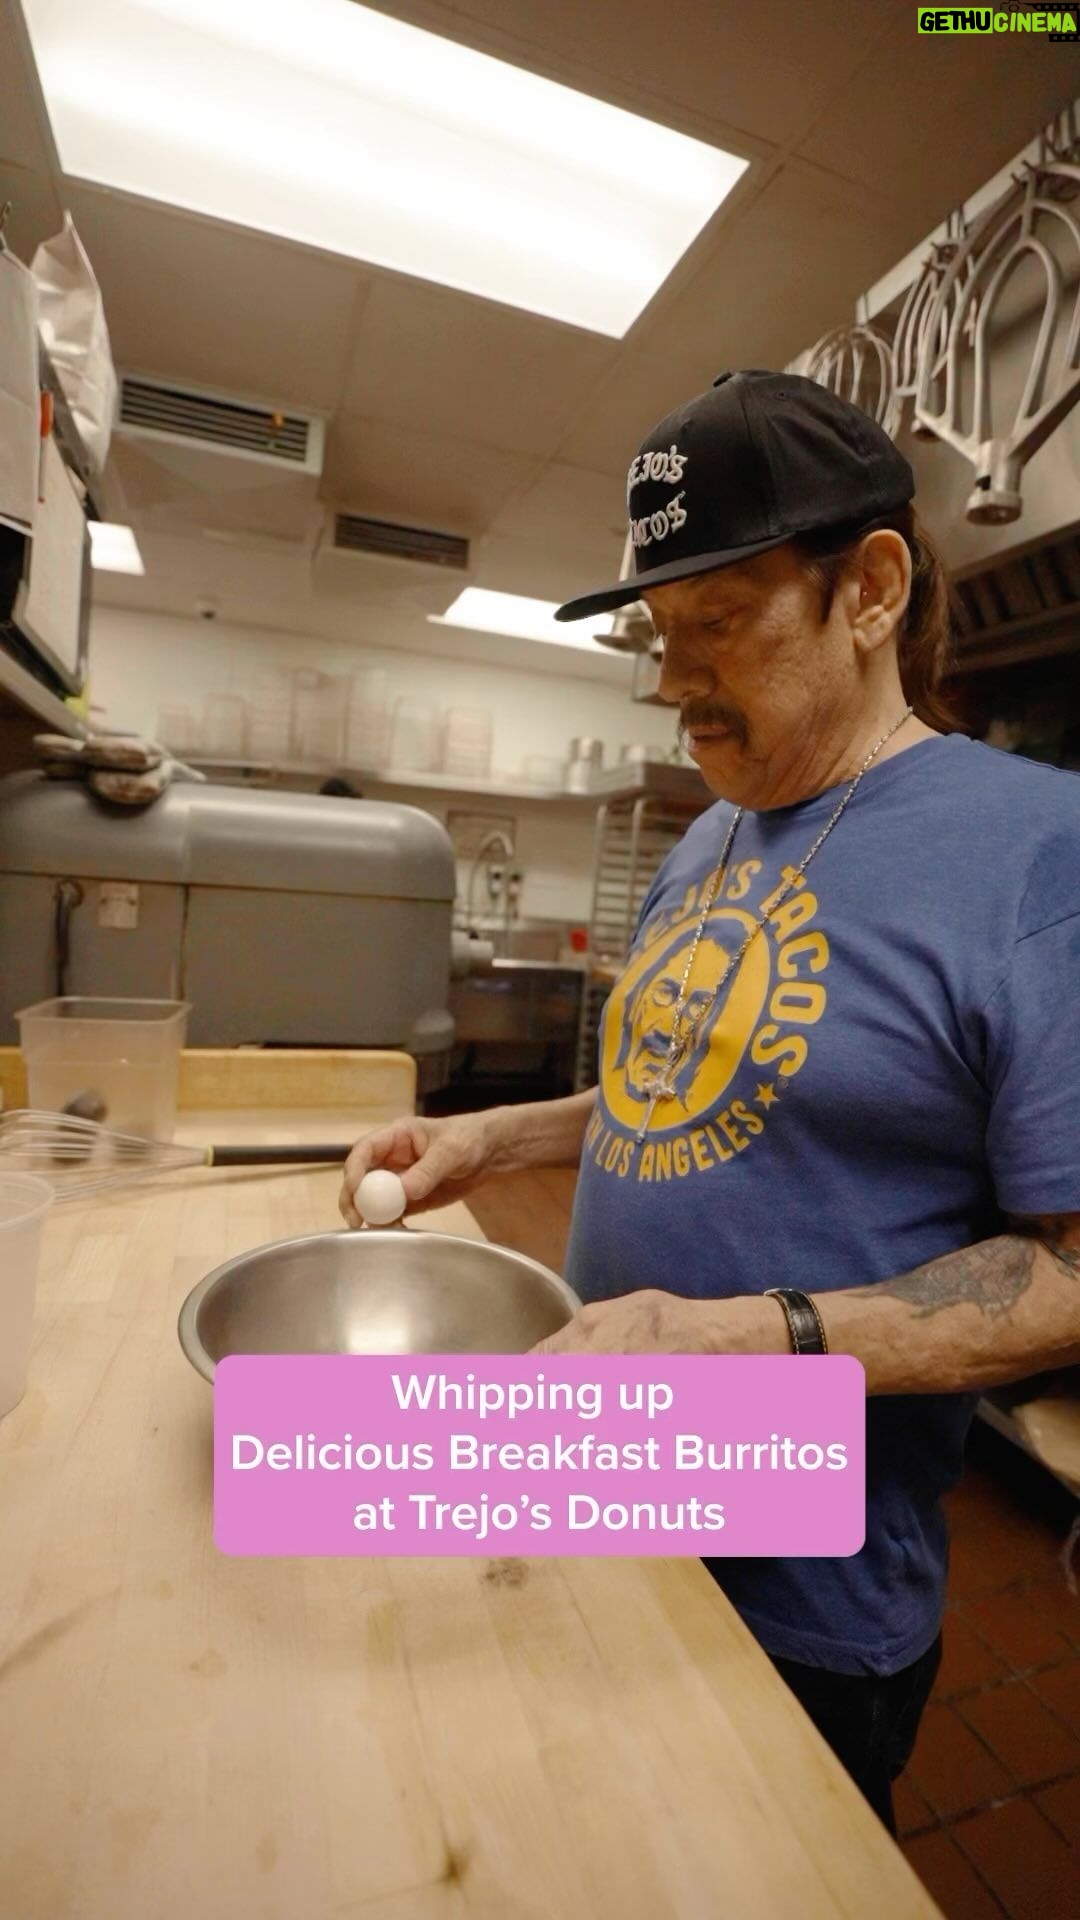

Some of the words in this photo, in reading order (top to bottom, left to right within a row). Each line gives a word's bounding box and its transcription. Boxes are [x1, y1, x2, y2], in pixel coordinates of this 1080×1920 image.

[627, 444, 689, 485] EJO'S
[751, 865, 830, 1078] TACOS
[594, 1129, 635, 1178] LOS
[638, 1100, 764, 1183] ANGELES
